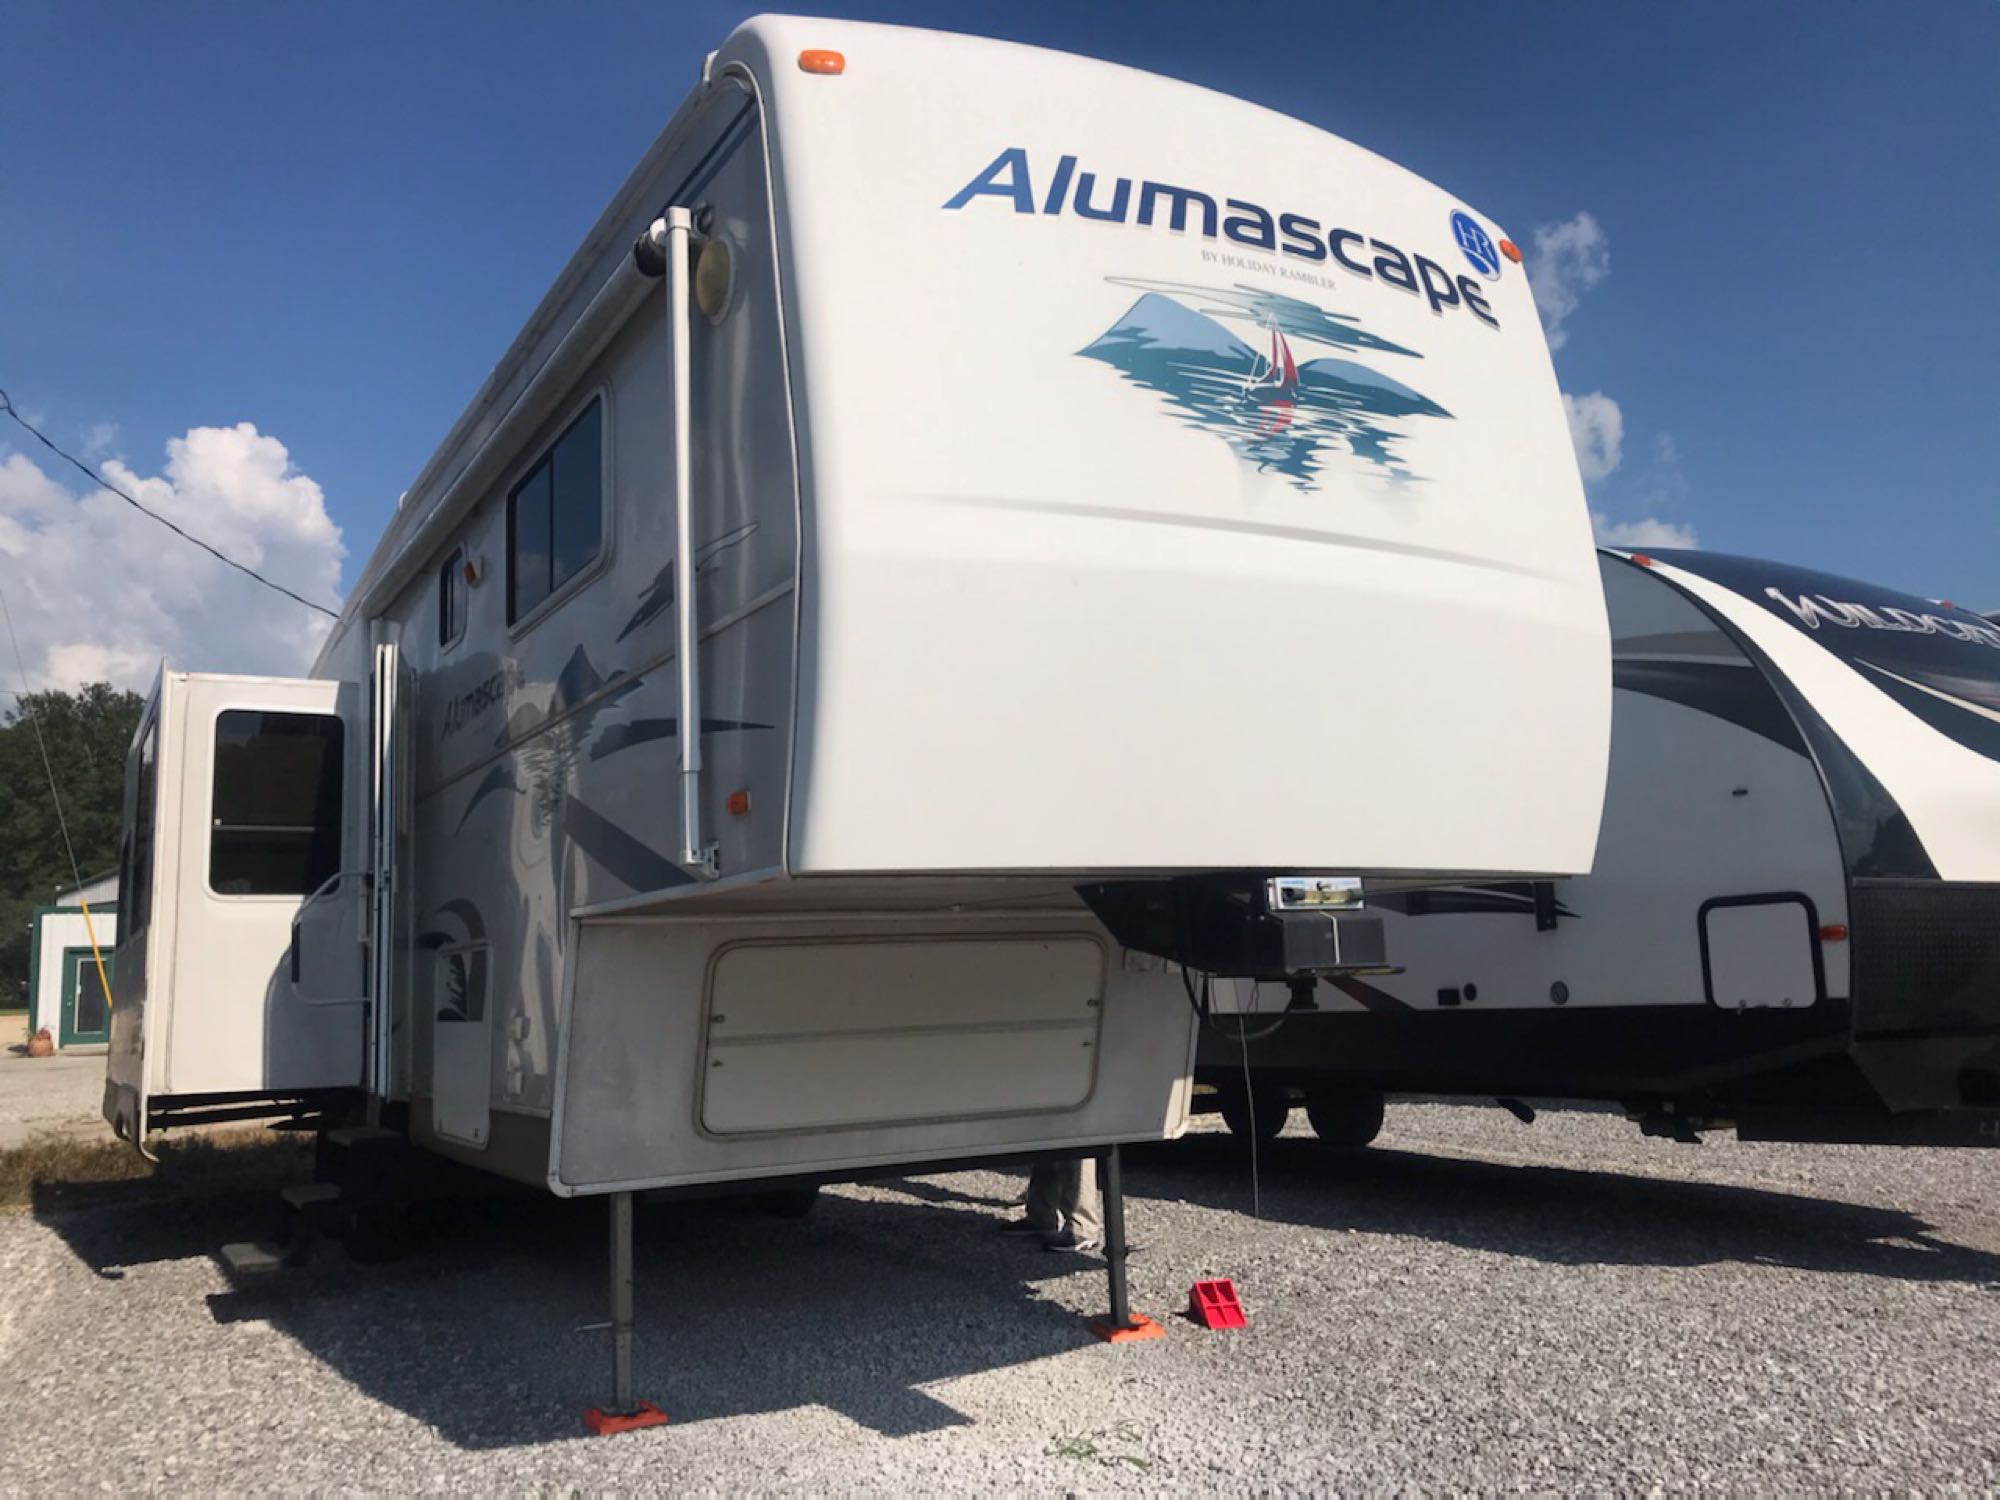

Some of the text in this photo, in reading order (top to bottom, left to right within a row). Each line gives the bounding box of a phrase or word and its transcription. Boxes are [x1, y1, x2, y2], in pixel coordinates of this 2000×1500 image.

[941, 147, 1499, 329] Alumascape
[1201, 249, 1337, 290] BY HOLIDAY RAMBLER
[1764, 586, 2000, 650] WILDCA
